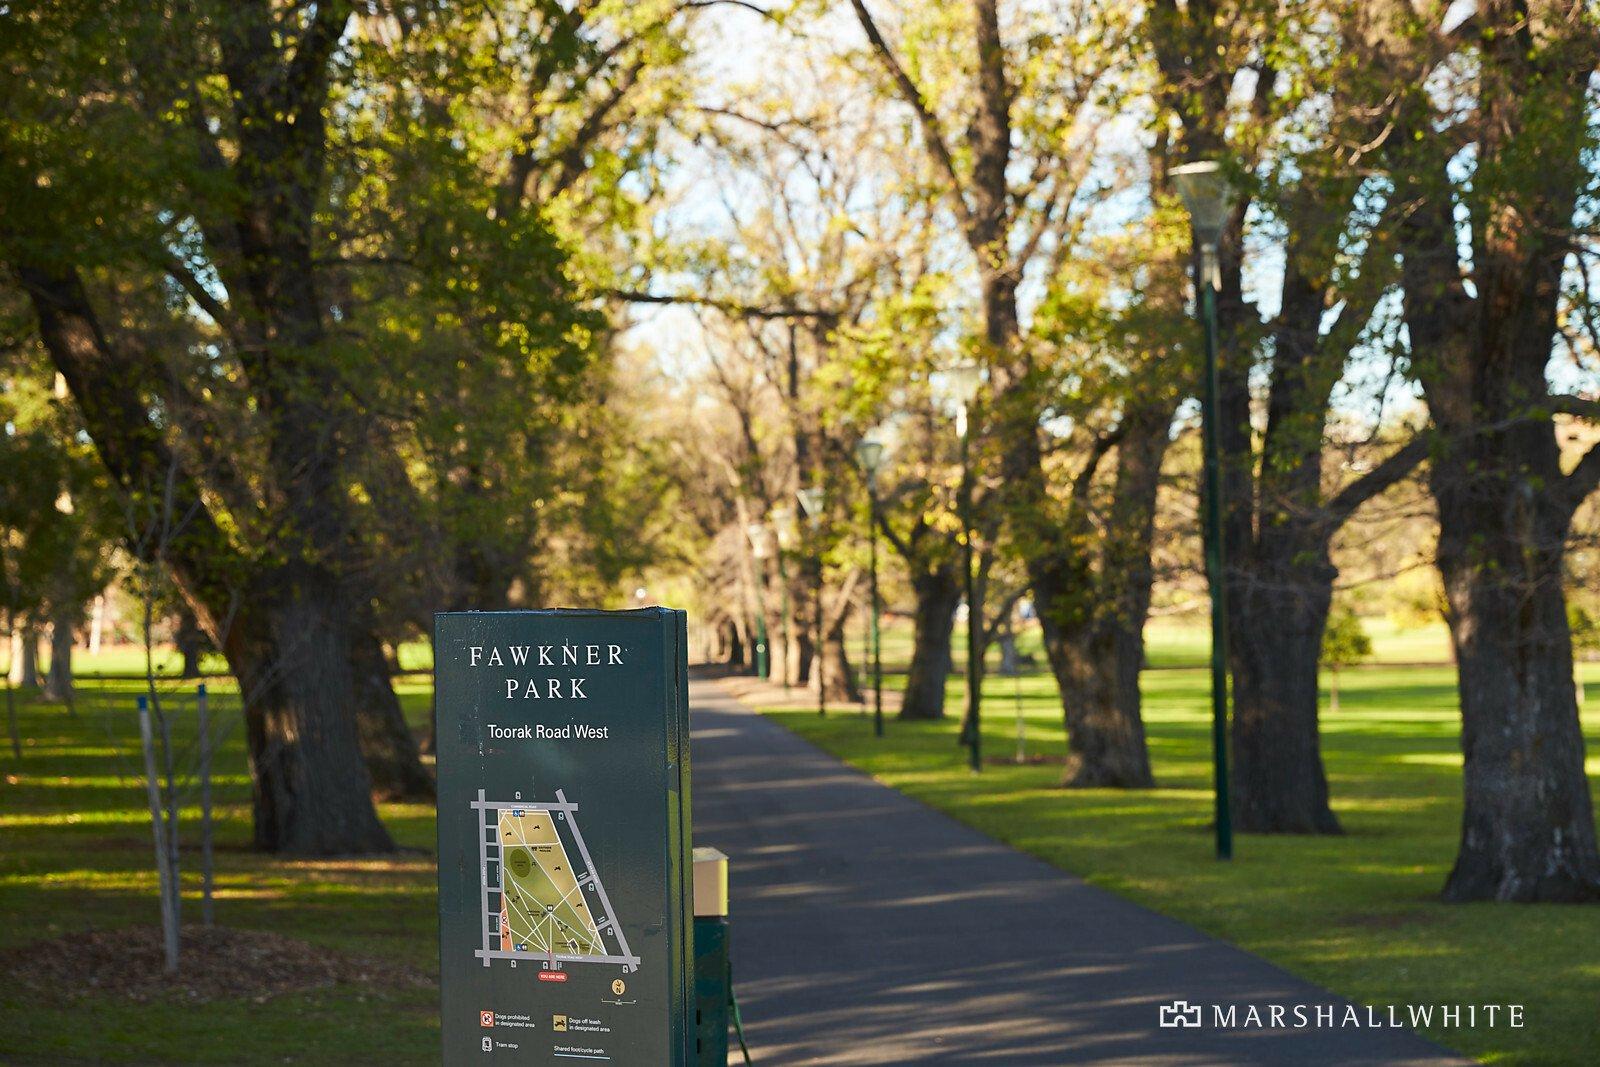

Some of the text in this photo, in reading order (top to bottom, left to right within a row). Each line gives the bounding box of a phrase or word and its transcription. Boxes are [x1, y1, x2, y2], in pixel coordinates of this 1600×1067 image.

[469, 644, 624, 666] FAWKNER
[505, 678, 588, 699] PARK
[487, 724, 609, 739] Toorak Road West
